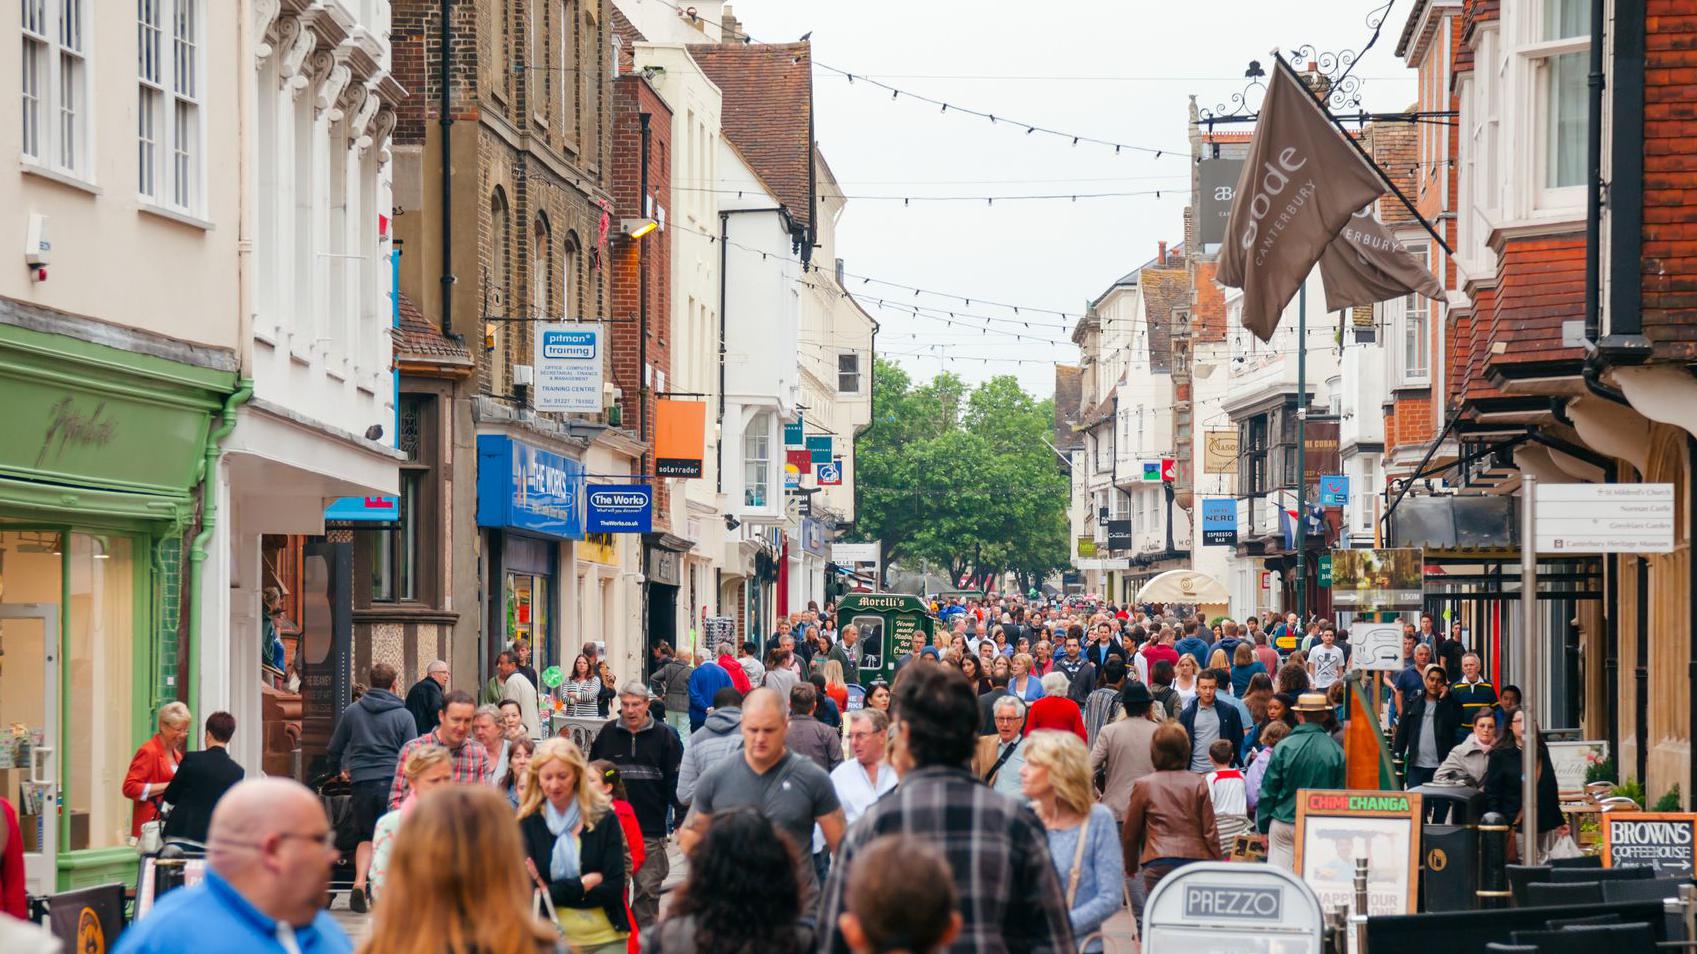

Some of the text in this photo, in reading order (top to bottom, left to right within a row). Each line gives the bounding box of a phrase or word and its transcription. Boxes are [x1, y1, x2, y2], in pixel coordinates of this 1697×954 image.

[1242, 147, 1307, 250] ode
[1255, 178, 1316, 266] CANTERBURY
[549, 334, 585, 344] pitman
[549, 346, 589, 356] training
[533, 462, 567, 500] THE WORKS
[595, 495, 644, 505] The Works
[1567, 540, 1604, 548] Canterbury
[1607, 540, 1637, 548] Heritage
[858, 597, 905, 607] Morelli's
[1610, 821, 1692, 844] BROWNS
[1611, 846, 1691, 859] COFFEEHOUSE
[1188, 890, 1277, 915] PREZZO
